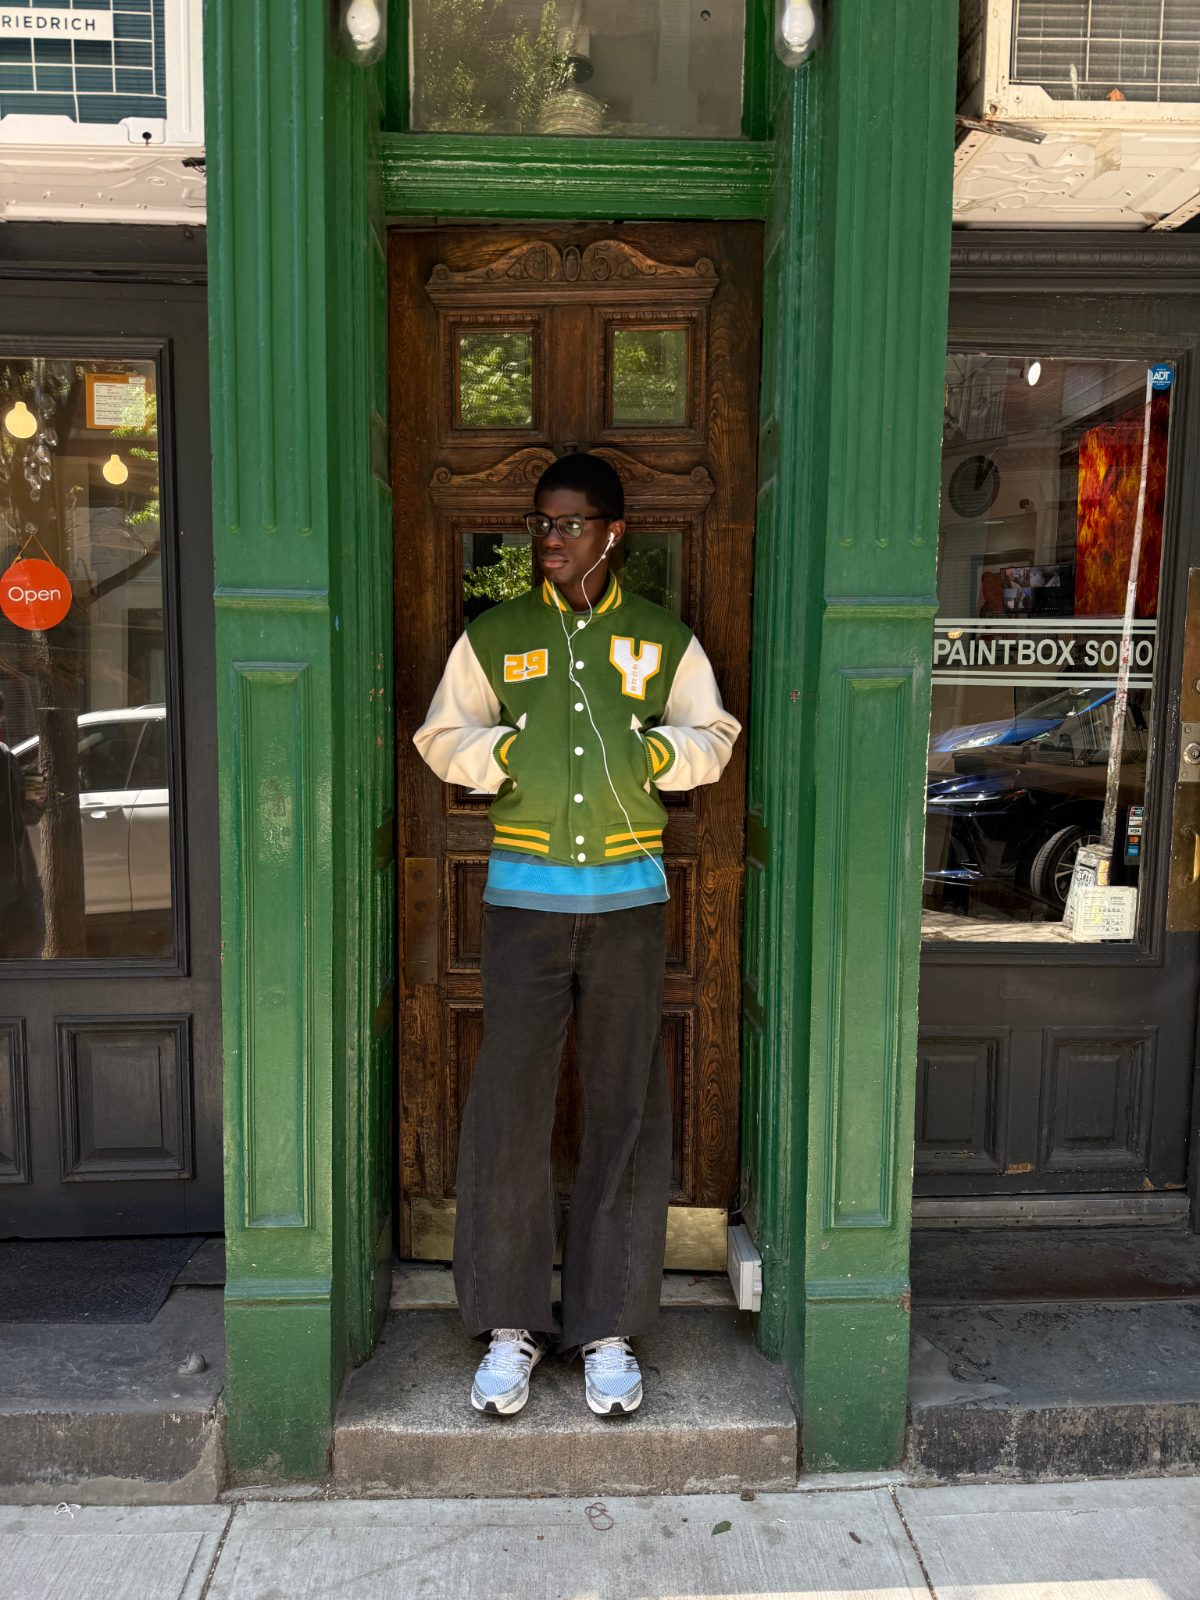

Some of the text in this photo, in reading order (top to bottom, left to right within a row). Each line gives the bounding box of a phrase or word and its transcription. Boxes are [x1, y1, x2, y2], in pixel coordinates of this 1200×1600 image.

[2, 15, 96, 31] RIEDRICH
[543, 245, 611, 282] 105
[1152, 371, 1171, 381] ADT
[8, 586, 61, 605] Open
[504, 648, 549, 682] 29
[933, 639, 1076, 666] PAINTBOX
[609, 635, 663, 701] Y
